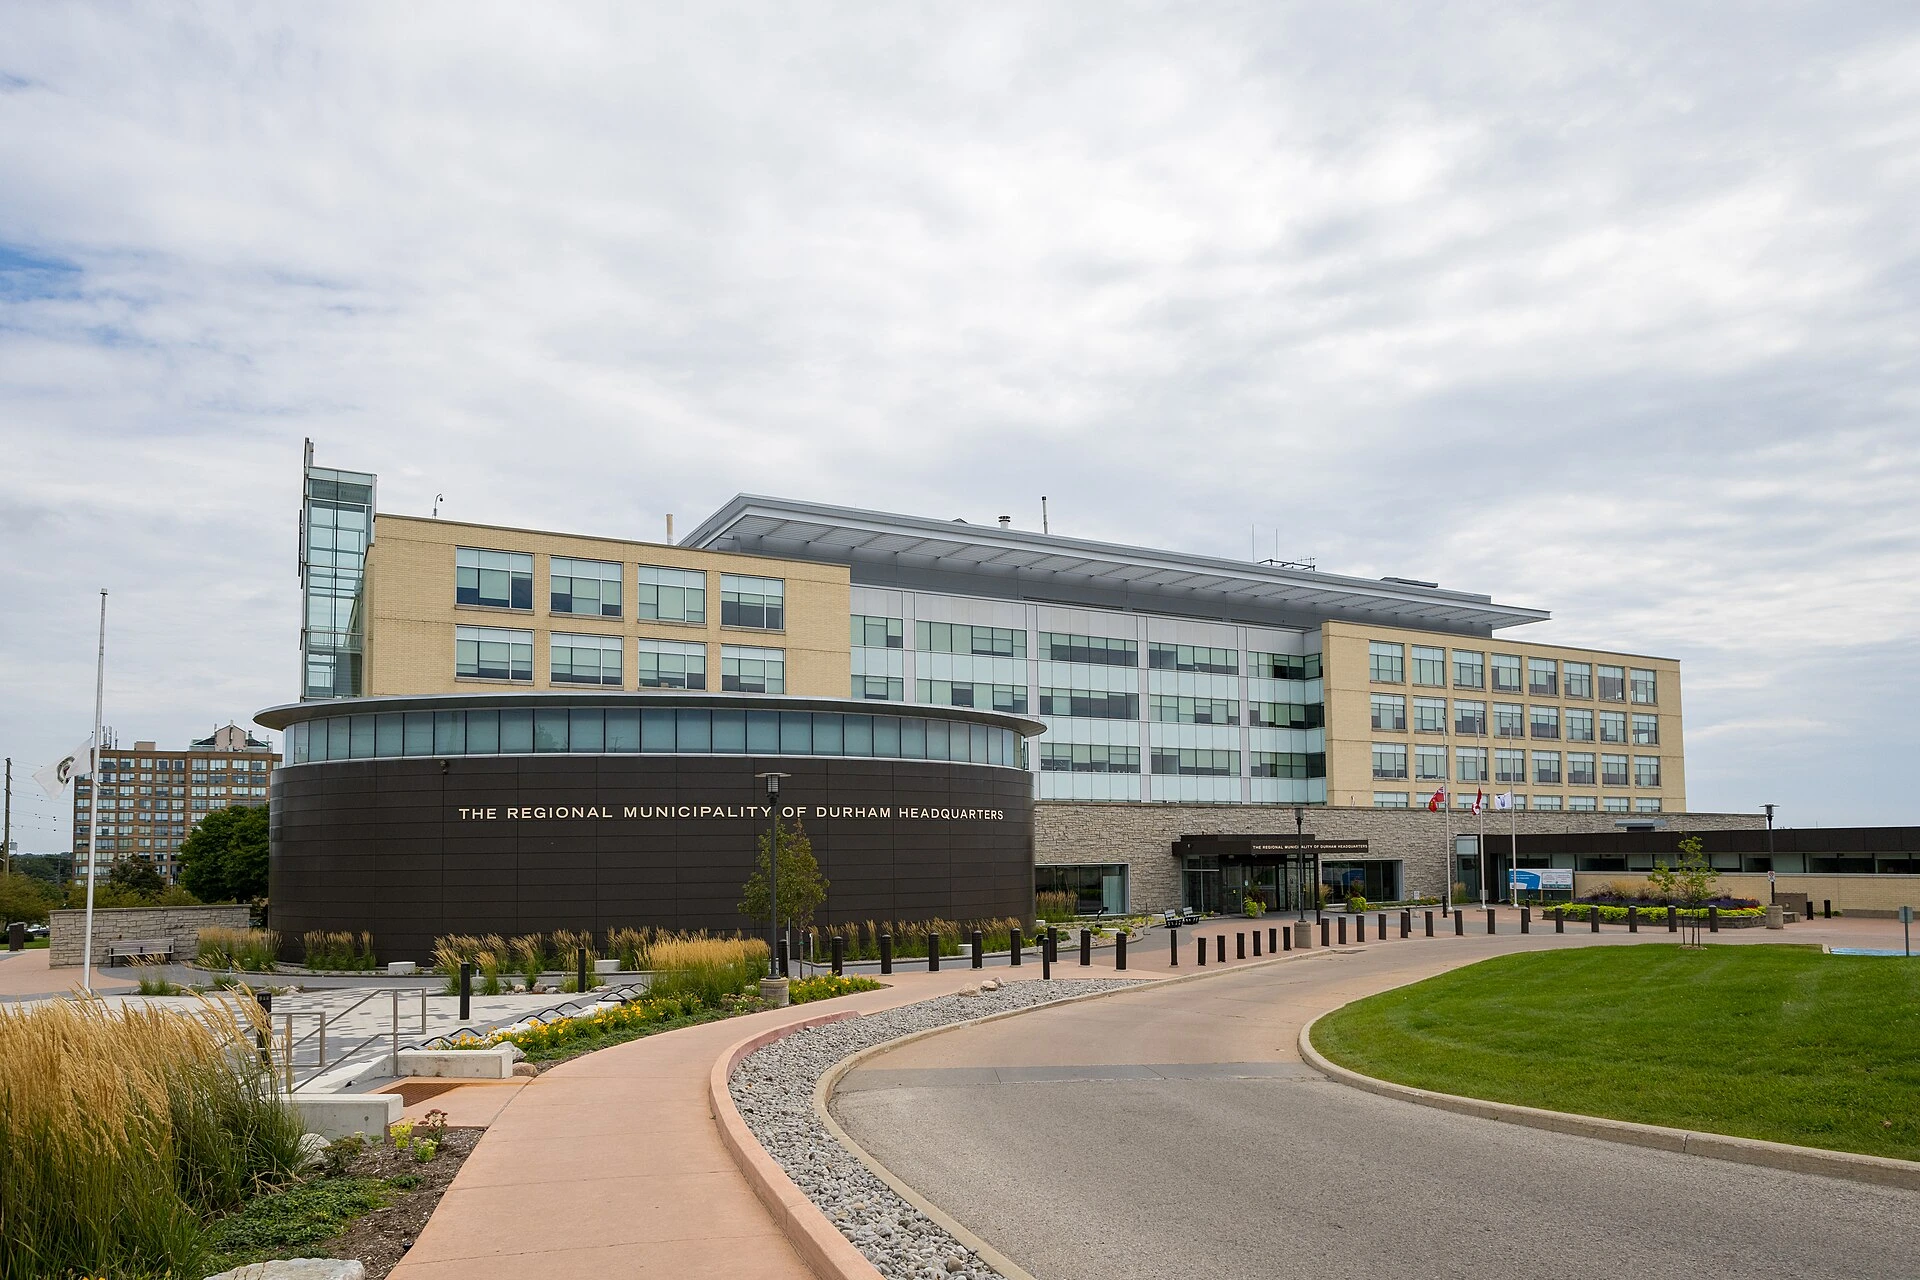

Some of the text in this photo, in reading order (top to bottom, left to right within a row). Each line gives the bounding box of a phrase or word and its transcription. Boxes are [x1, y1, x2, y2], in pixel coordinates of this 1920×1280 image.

[459, 806, 1004, 820] THE REGIONAL MUNICIPALITY OF DURHAM HEADQUARTERS
